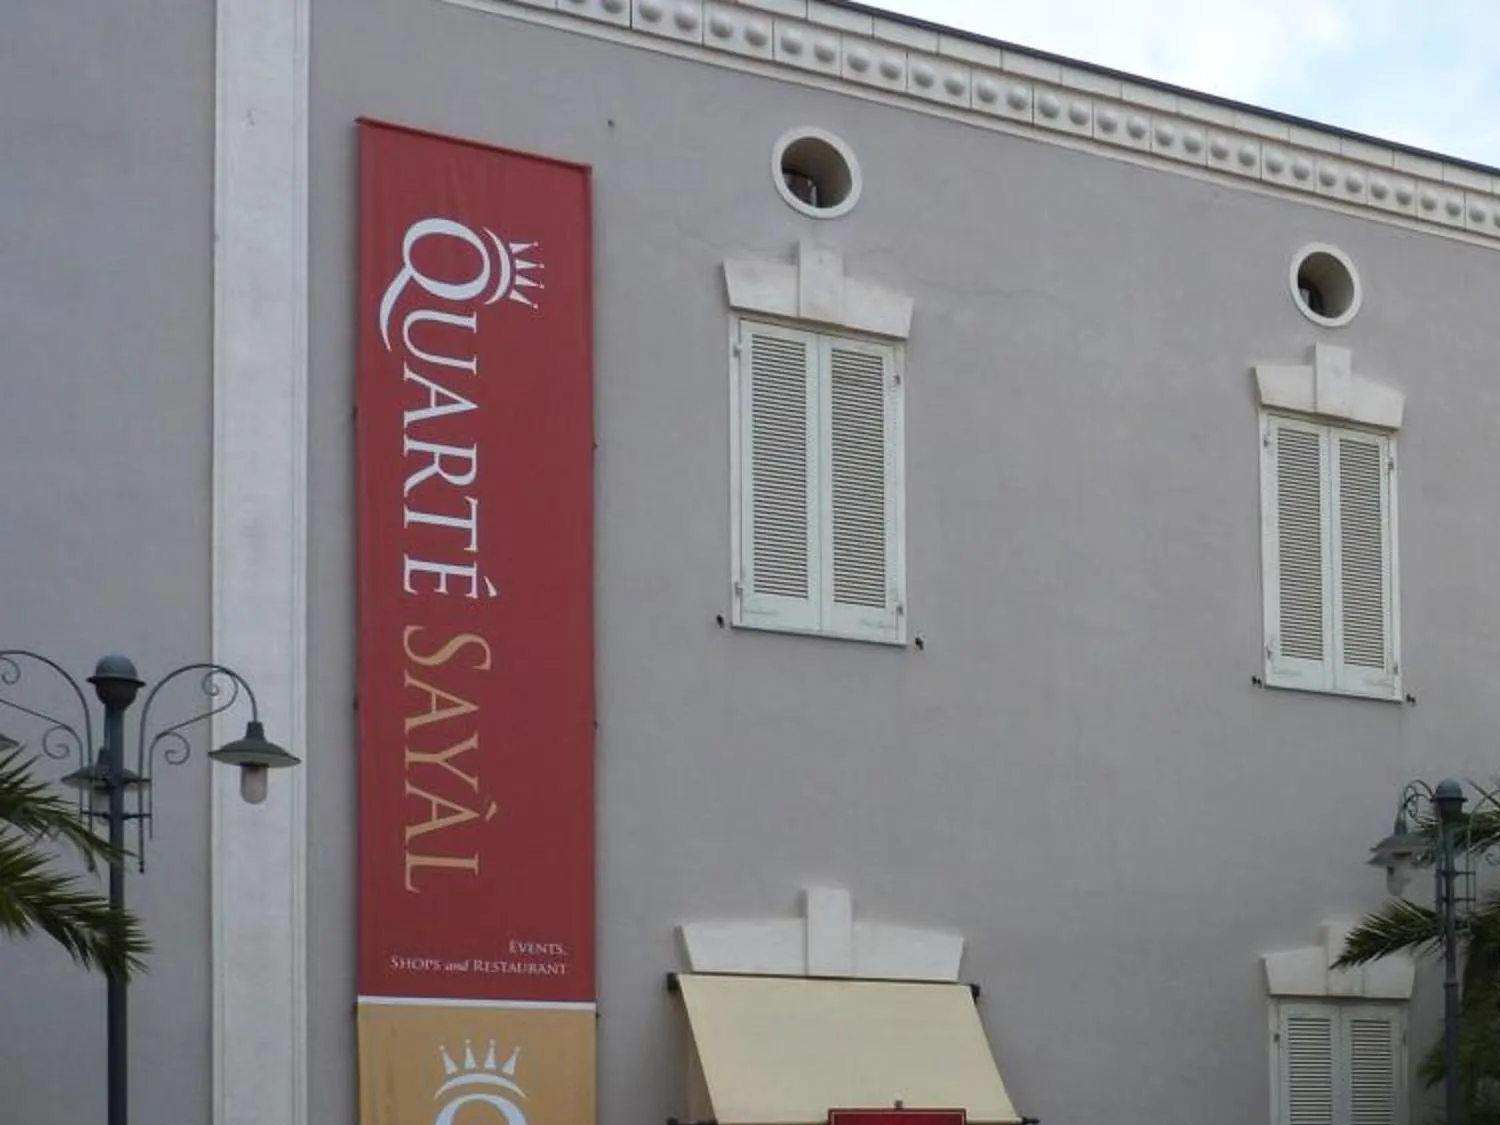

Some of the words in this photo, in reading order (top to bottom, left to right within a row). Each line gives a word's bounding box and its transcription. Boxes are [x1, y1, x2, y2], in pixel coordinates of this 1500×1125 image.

[402, 624, 498, 894] SAYÀL
[390, 953, 442, 972] SHOPS
[444, 959, 471, 972] and
[472, 959, 567, 976] RESTAURANT
